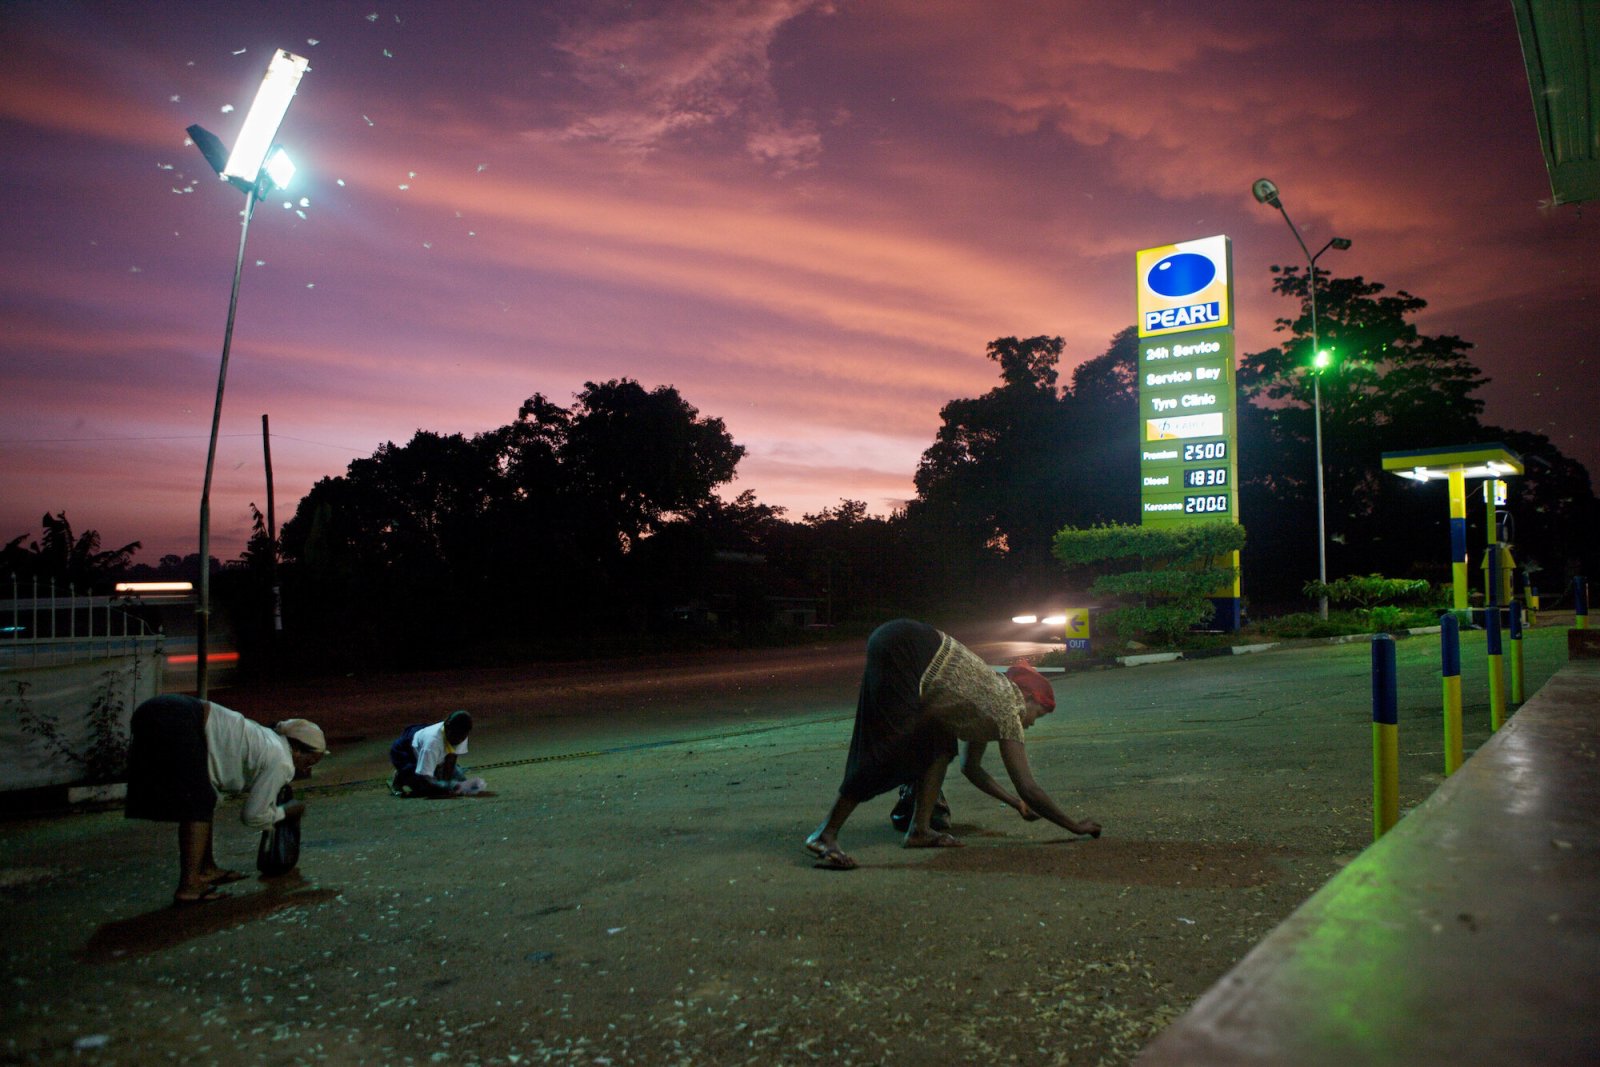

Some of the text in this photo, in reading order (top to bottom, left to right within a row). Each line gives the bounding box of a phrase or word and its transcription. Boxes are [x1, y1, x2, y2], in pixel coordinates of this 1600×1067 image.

[1146, 303, 1219, 330] PEARL
[1146, 341, 1220, 360] 24h Service
[1146, 367, 1221, 386] Service Bay
[1152, 393, 1216, 412] Tyre Clinic
[1184, 443, 1225, 460] 2500
[1190, 469, 1226, 486] 1830
[1186, 496, 1227, 512] 2000
[1069, 639, 1086, 648] OUT
